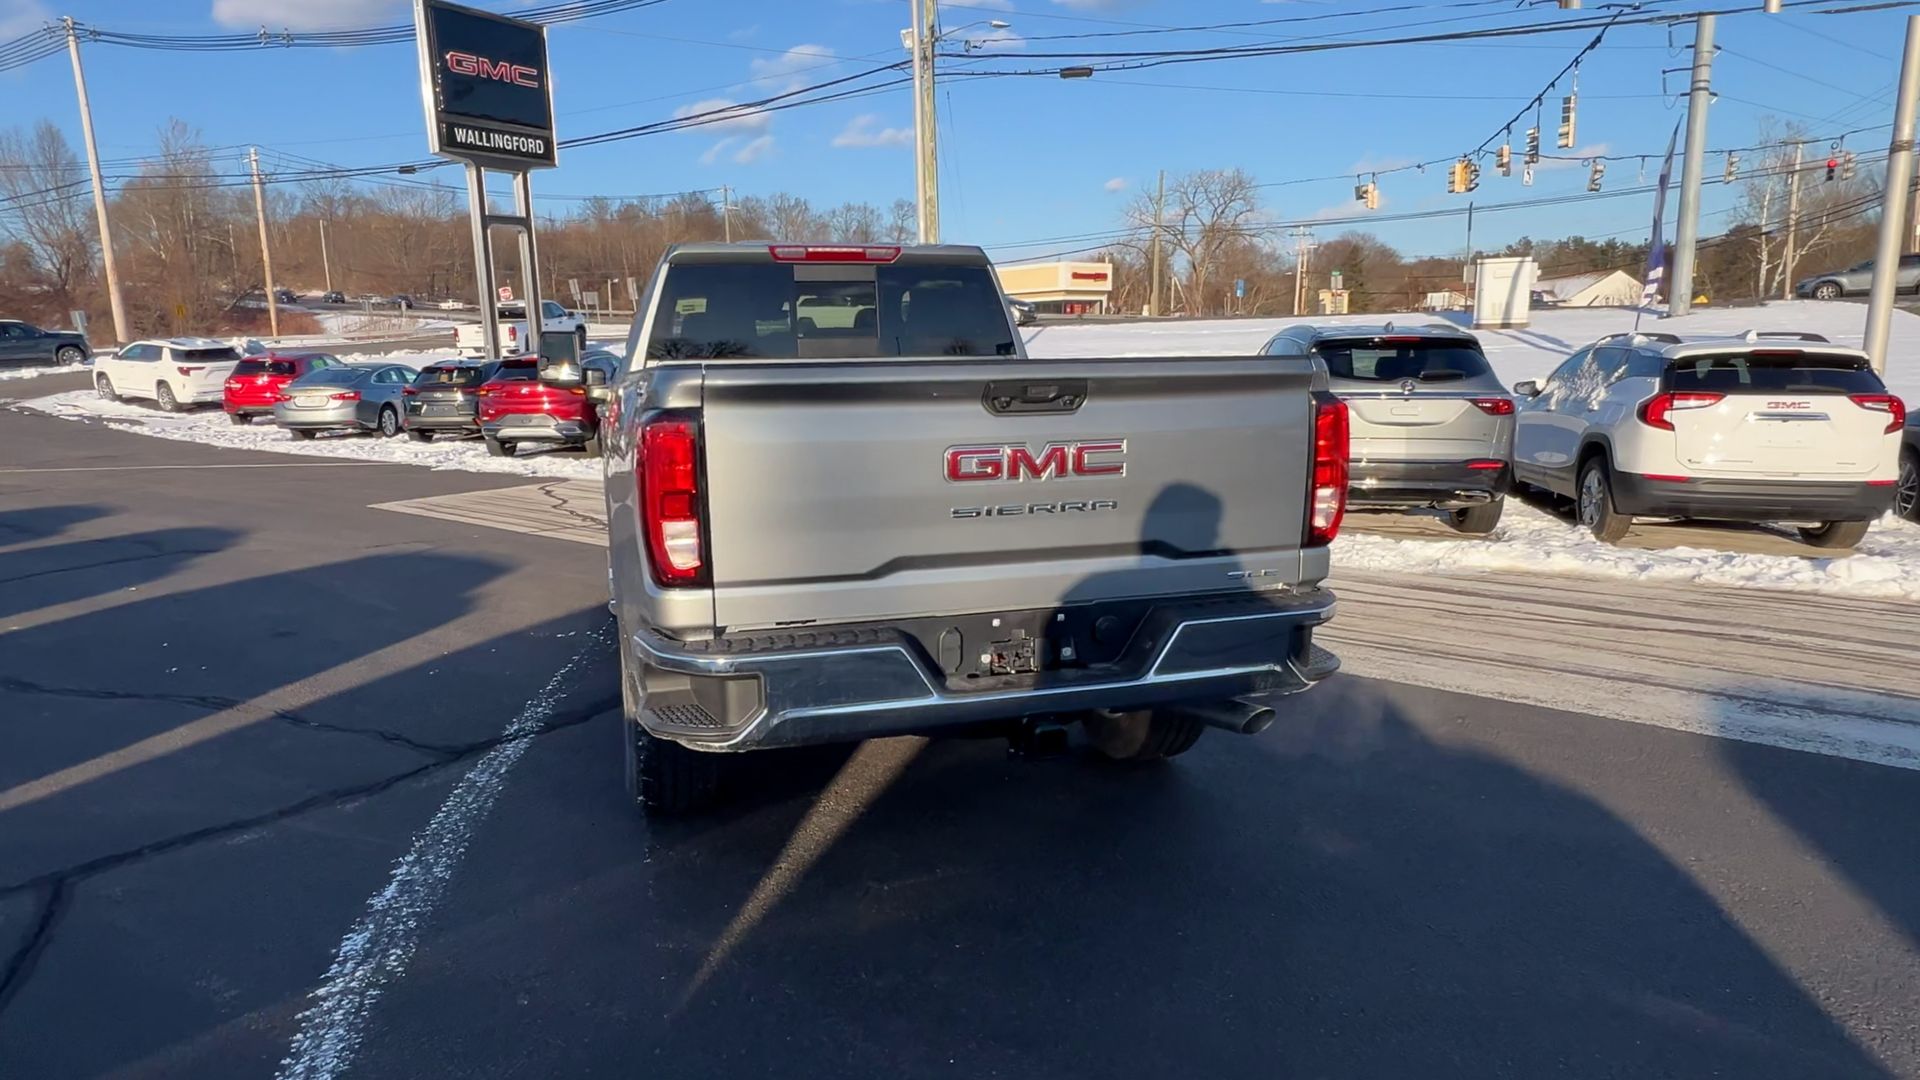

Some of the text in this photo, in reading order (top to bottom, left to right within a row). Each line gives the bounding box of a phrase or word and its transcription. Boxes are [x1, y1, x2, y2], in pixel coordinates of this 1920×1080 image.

[446, 51, 538, 88] GMC
[454, 127, 544, 154] WALLINGFORD
[1767, 401, 1810, 409] GMC
[943, 438, 1127, 485] GMC
[950, 500, 1118, 519] SIERRA
